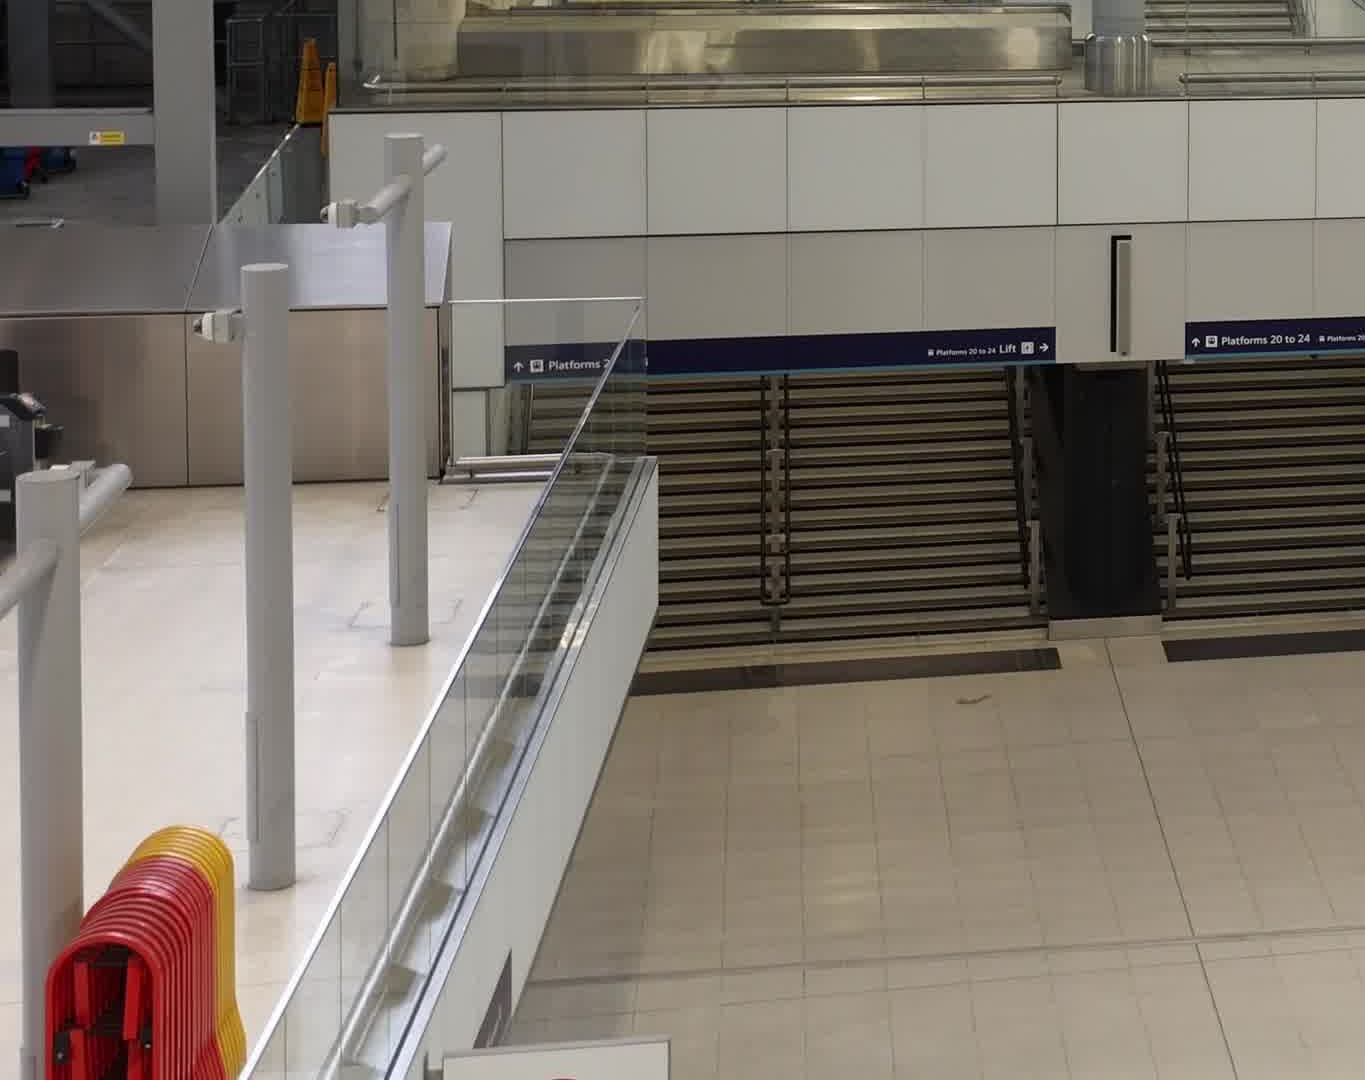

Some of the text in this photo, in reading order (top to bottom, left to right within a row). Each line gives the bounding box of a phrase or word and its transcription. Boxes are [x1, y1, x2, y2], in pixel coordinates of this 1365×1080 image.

[1221, 333, 1311, 346] Platforms 20 to 24
[1326, 334, 1356, 343] Platforms
[936, 349, 968, 357] Platforms
[968, 347, 978, 356] 20
[987, 347, 996, 355] 24
[1000, 343, 1017, 354] Lift
[549, 359, 601, 371] Platforms
